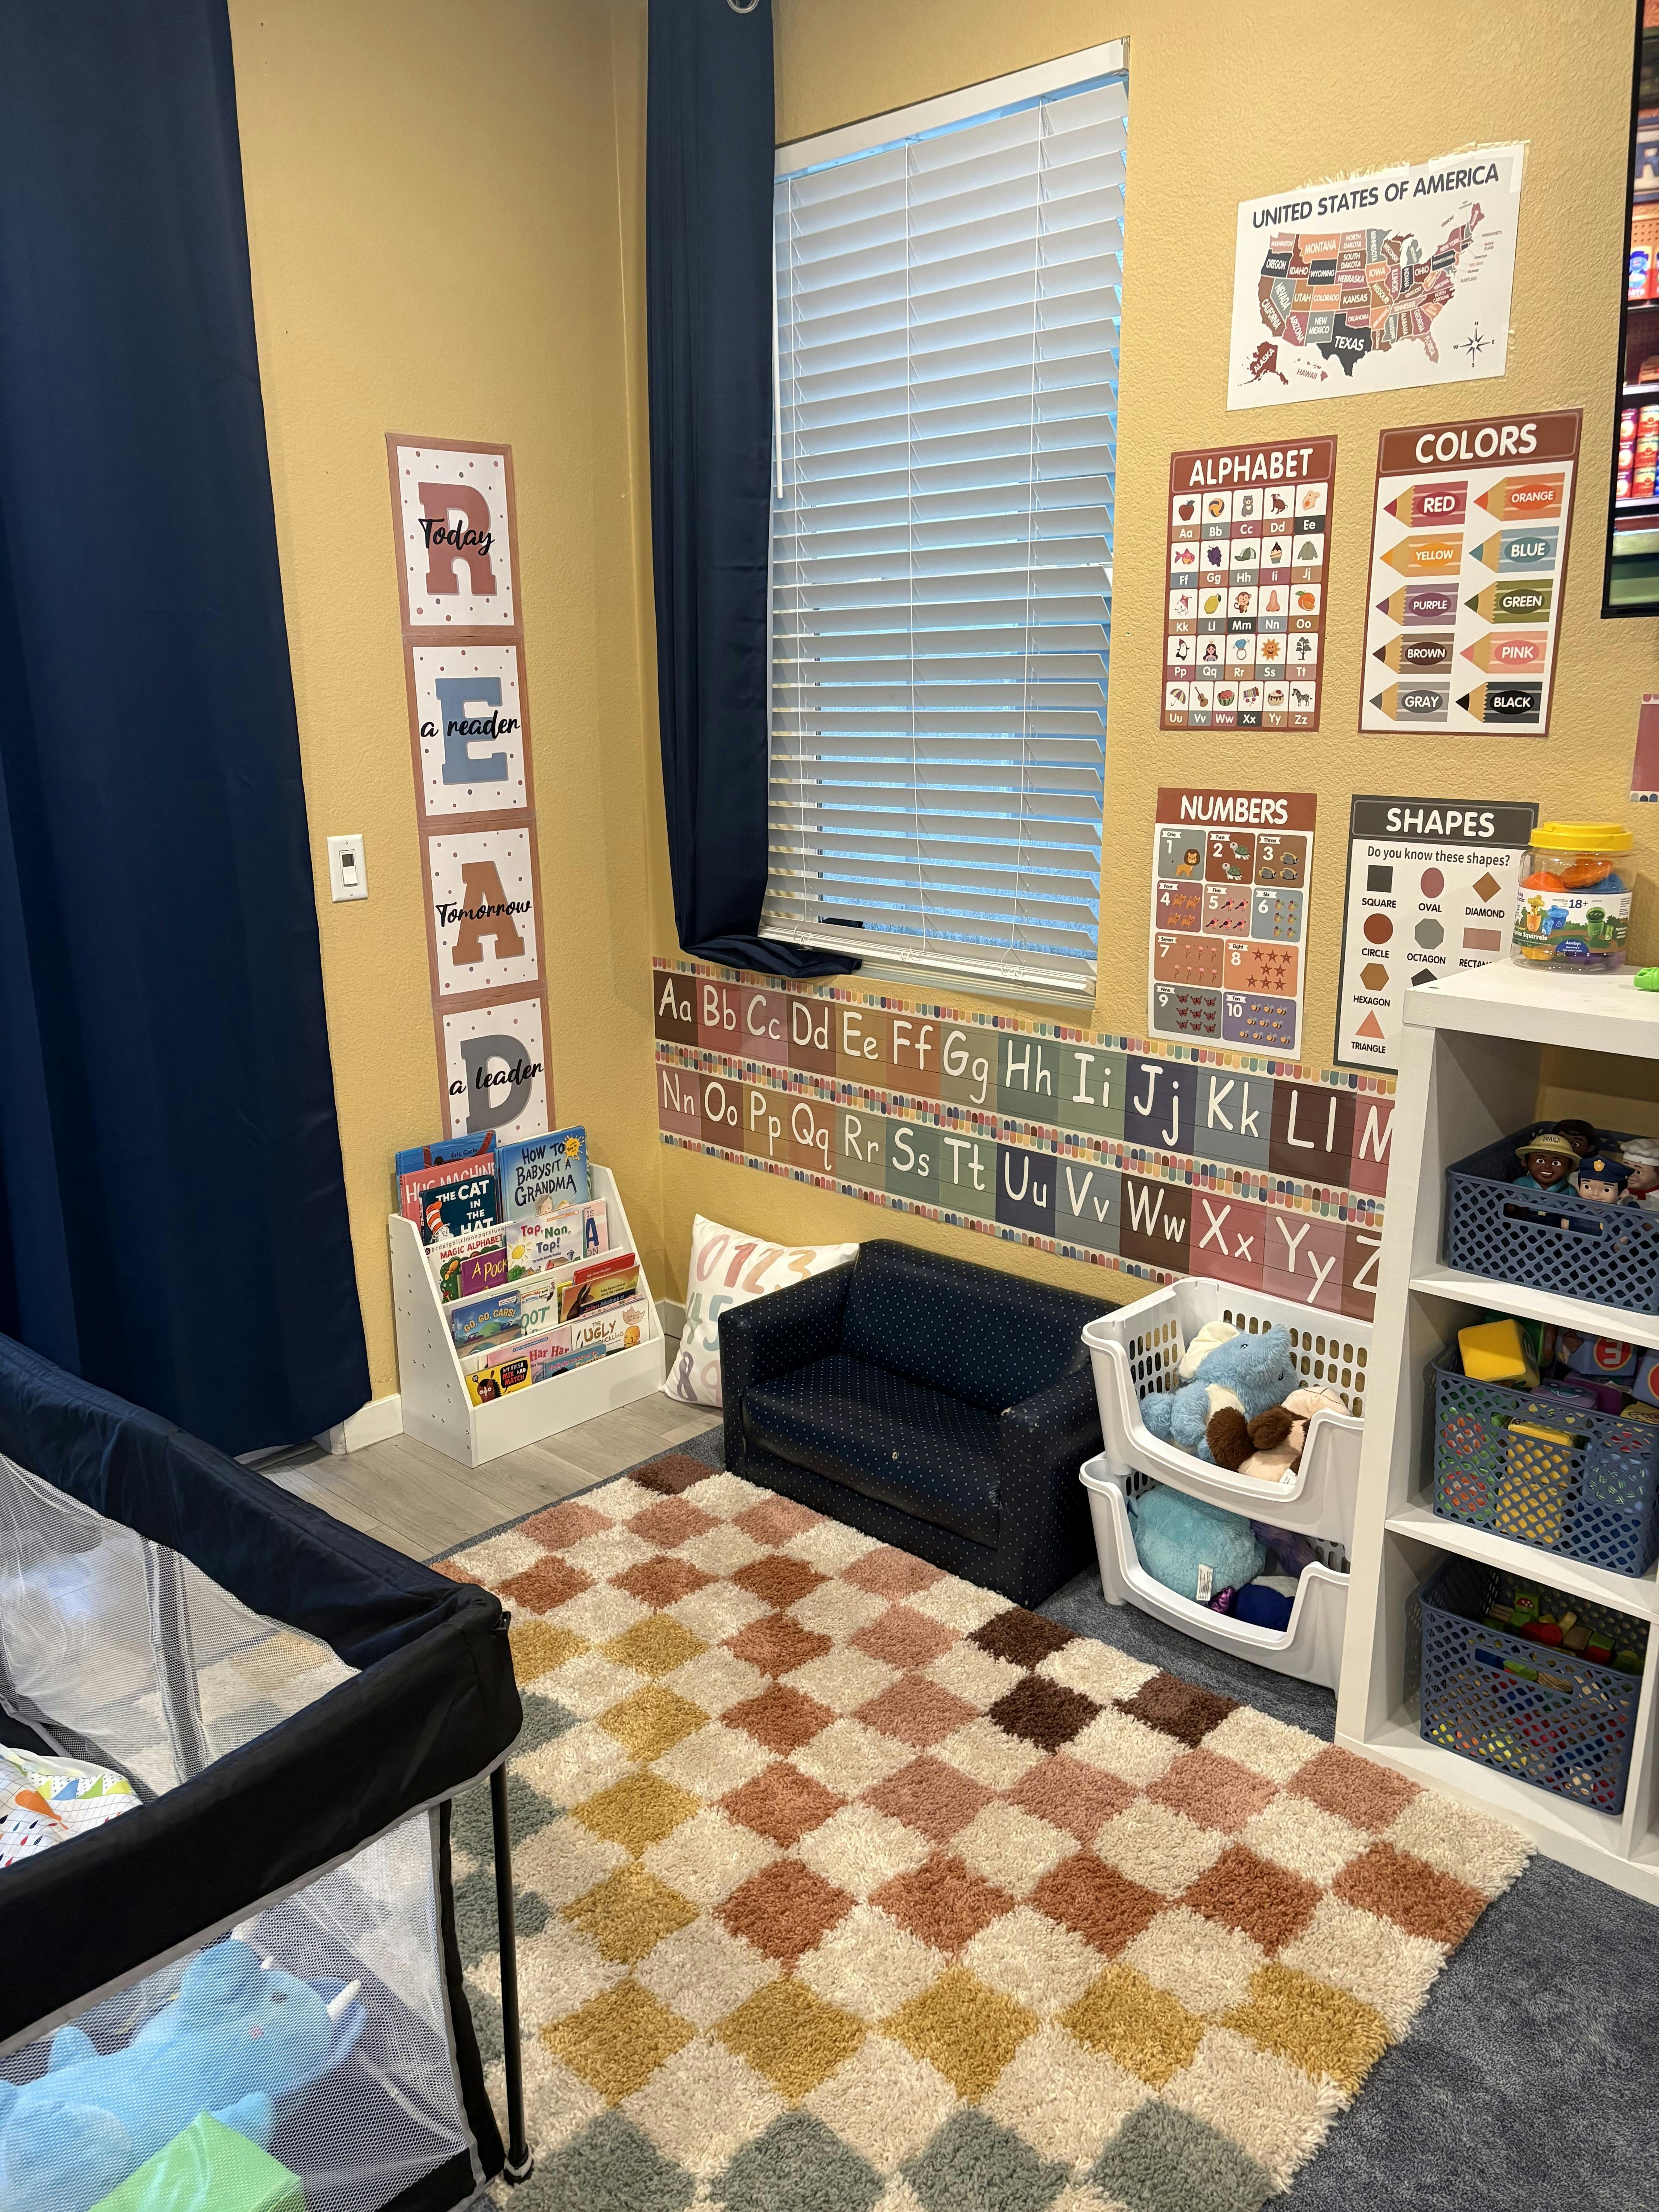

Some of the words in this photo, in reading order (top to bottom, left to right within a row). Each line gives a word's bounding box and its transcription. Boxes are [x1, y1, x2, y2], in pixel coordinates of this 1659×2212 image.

[1253, 200, 1312, 228] UNITED
[1317, 185, 1379, 216] STATES
[1384, 181, 1408, 201] OF
[1413, 163, 1499, 197] AMERICA
[1305, 239, 1336, 254] MONTANA
[1266, 259, 1286, 270] OREGON
[1290, 267, 1308, 275] IDAHO
[1415, 265, 1429, 276] OHIO
[1310, 270, 1334, 278] WYOMING
[1338, 275, 1364, 283] NEBRASKA
[1369, 267, 1385, 277] IOWA
[1275, 282, 1291, 311] NEVADA
[1294, 293, 1311, 302] UTAH
[1314, 294, 1340, 302] COLORADO
[1343, 294, 1367, 304] KANSAS
[1261, 299, 1281, 330] CALIFORNIA
[1314, 316, 1328, 325] NEW
[1290, 315, 1304, 343] ARIZONA
[1309, 326, 1329, 335] MEXICO
[1335, 335, 1365, 351] TEXAS
[1254, 348, 1275, 373] ALASKA
[1297, 369, 1317, 380] HAWAII
[1416, 423, 1537, 464] COLORS
[1189, 448, 1313, 486] ALPHABET
[1511, 491, 1554, 503] ORANGE
[1424, 496, 1455, 513] RED
[1179, 528, 1192, 538] Aa
[1209, 526, 1222, 537] Bb
[1240, 524, 1253, 534] Cc
[1271, 521, 1285, 533] Dd
[1304, 520, 1316, 530] Ee
[418, 519, 495, 556] Today
[418, 482, 497, 596] R
[1415, 550, 1453, 561] YELLOW
[1511, 543, 1545, 557] BLUE
[1180, 575, 1188, 584] Ff
[1207, 573, 1221, 584] Gg
[1237, 571, 1250, 582] Hh
[1272, 570, 1278, 581] Ii
[1303, 568, 1311, 580] Jj
[1413, 600, 1447, 610] PURPLE
[1503, 595, 1542, 607] GREEN
[1176, 622, 1188, 632] Kk
[1208, 621, 1215, 631] Ll
[1232, 620, 1251, 630] Mm
[1266, 620, 1279, 629] Nn
[1296, 619, 1311, 629] Oo
[1407, 649, 1446, 658] BROWN
[1501, 646, 1534, 659] PINK
[1175, 667, 1187, 678] Pp
[1203, 666, 1217, 678] Qq
[1234, 668, 1244, 677] Rr
[1264, 668, 1275, 677] Ss
[1296, 667, 1306, 677] Tt
[1405, 696, 1439, 708] GRAY
[1494, 697, 1531, 708] BLACK
[421, 721, 438, 737] a
[447, 710, 520, 739] reader
[1170, 713, 1182, 723] Uu
[1194, 714, 1206, 723] Vv
[1216, 714, 1233, 723] Ww
[1243, 714, 1255, 724] Xx
[1269, 713, 1281, 725] Yy
[1295, 715, 1307, 725] Zz
[435, 677, 508, 785] E
[1180, 795, 1288, 824] NUMBERS
[1386, 807, 1494, 837] SHAPES
[1166, 840, 1172, 854] 1
[1212, 843, 1223, 857] 2
[1263, 846, 1273, 861] 3
[1368, 846, 1380, 857] Do
[1383, 850, 1401, 860] you
[1405, 850, 1432, 861] know
[1436, 851, 1463, 863] these
[1467, 855, 1510, 867] shapes?
[1160, 892, 1171, 906] 4
[1208, 895, 1218, 909] 5
[1362, 898, 1396, 908] SQUARE
[1569, 900, 1588, 908] 18+
[436, 900, 532, 927] Tomorrow
[452, 861, 525, 966] A
[1258, 900, 1269, 914] 6
[1419, 903, 1442, 912] OVAL
[1465, 907, 1504, 918] DIAMOND
[1523, 931, 1547, 941] Squirrels
[1160, 944, 1170, 958] 7
[1362, 948, 1389, 958] CIRCLE
[1231, 952, 1241, 965] 8
[1407, 953, 1446, 964] OCTAGON
[1159, 994, 1168, 1007] 9
[1353, 996, 1390, 1007] HEXAGON
[1227, 1003, 1243, 1018] 10
[1351, 1042, 1386, 1053] TRIANGLE
[659, 978, 692, 1022] Aa
[704, 985, 736, 1030] Bb
[747, 994, 780, 1040] Cc
[793, 1001, 828, 1050] Dd
[843, 1011, 878, 1060] Ee
[894, 1020, 933, 1070] Ff
[943, 1030, 988, 1104] Gg
[1006, 1040, 1051, 1096] Hh
[1073, 1053, 1111, 1107] Ii
[1134, 1064, 1179, 1146] Jj
[1208, 1076, 1259, 1137] Kk
[1288, 1090, 1337, 1152] Ll
[450, 1080, 466, 1095] a
[476, 1059, 544, 1089] leader
[460, 1034, 532, 1134] D
[522, 1145, 546, 1164] HOW
[550, 1142, 565, 1156] TO
[516, 1159, 561, 1186] BABYSIT
[565, 1159, 571, 1170] A
[436, 1191, 456, 1202] THE
[458, 1180, 489, 1200] CAT
[515, 1175, 577, 1206] GRANDMA
[663, 1070, 694, 1115] Nn
[705, 1082, 737, 1126] Oo
[751, 1091, 781, 1156] Pp
[792, 1103, 832, 1171] Qq
[845, 1114, 879, 1163] Rr
[892, 1127, 929, 1176] Ss
[944, 1137, 985, 1190] Tt
[1005, 1152, 1046, 1208] Uu
[1066, 1166, 1109, 1222] Vv
[1128, 1180, 1185, 1243] Ww
[1199, 1199, 1254, 1262] Xx
[1276, 1217, 1336, 1303] Yy
[470, 1199, 481, 1209] IN
[467, 1209, 484, 1220] THE
[460, 1217, 493, 1235] HAT
[521, 1225, 543, 1237] Tap,
[545, 1225, 571, 1238] Nan,
[440, 1246, 464, 1259] MAGIC
[467, 1234, 503, 1252] ALPHABET
[536, 1237, 560, 1253] Tap!
[464, 1320, 477, 1332] GO,
[478, 1312, 491, 1323] GO,
[493, 1309, 516, 1317] CARS!
[584, 1321, 616, 1342] UGLY
[529, 1349, 548, 1362] Har
[551, 1346, 569, 1357] Har
[505, 1374, 524, 1386] MATCH
